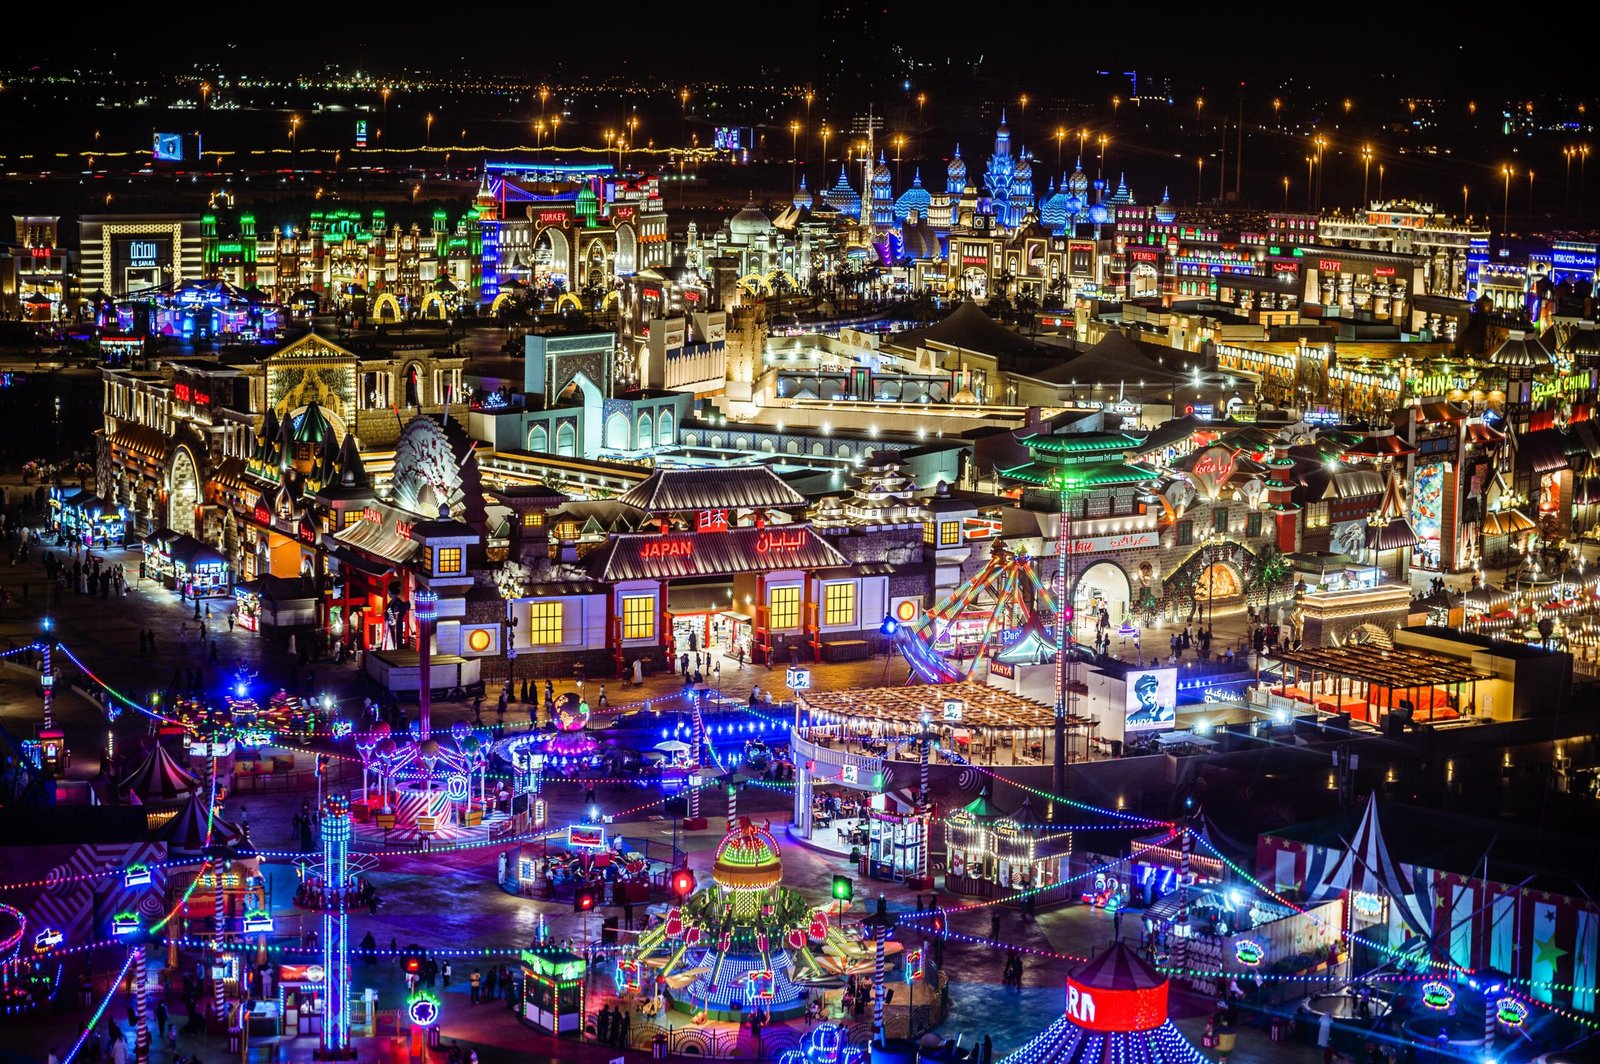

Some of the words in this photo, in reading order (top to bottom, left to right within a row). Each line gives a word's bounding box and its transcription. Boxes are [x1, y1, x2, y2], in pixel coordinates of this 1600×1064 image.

[540, 213, 567, 222] TURKEY
[32, 248, 51, 257] UAE
[1132, 251, 1158, 261] YEMEN
[1553, 253, 1575, 263] MOROCCO
[1319, 260, 1342, 272] EGYPT
[1413, 375, 1454, 394] CHINA
[1563, 372, 1590, 390] CHINA
[1195, 463, 1216, 475] Korea
[363, 507, 383, 526] JAPAN
[699, 510, 727, 528] 日本
[756, 531, 807, 552] اليابان
[640, 542, 692, 558] JAPAN
[991, 662, 1012, 678] YAHYA
[1126, 718, 1154, 728] YAHYA
